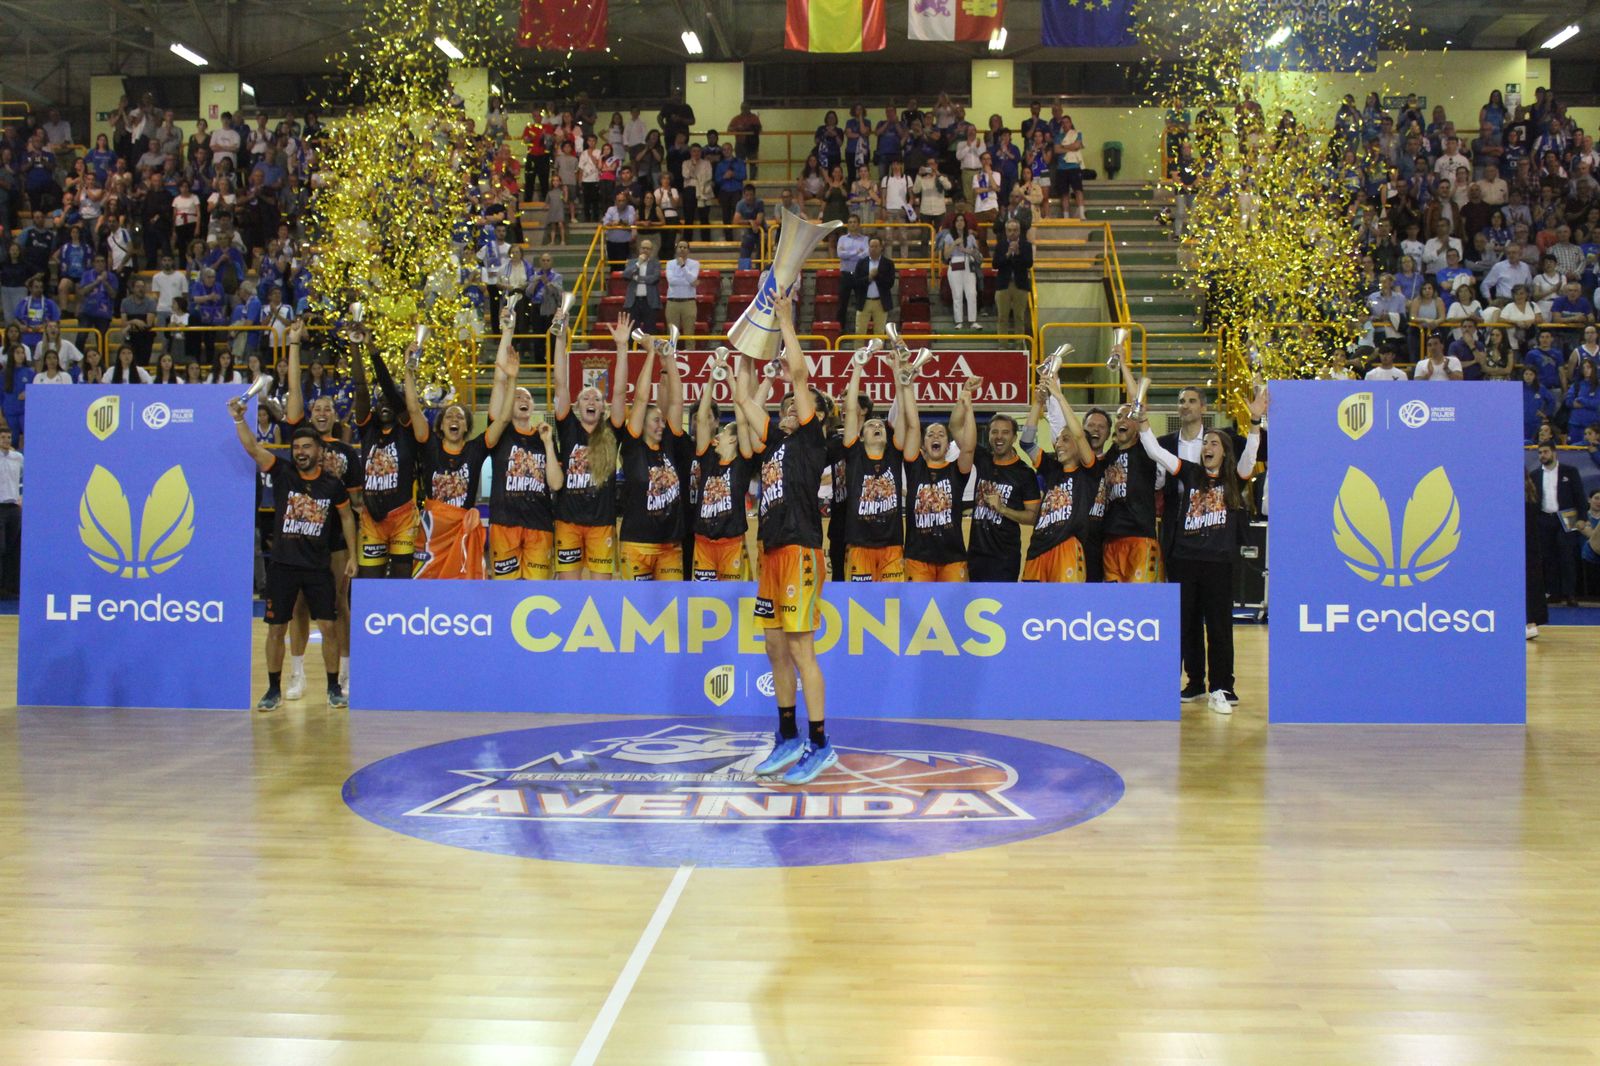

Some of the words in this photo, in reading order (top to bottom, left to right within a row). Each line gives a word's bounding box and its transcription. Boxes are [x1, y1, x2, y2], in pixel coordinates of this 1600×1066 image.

[675, 354, 977, 378] SALMACA
[864, 382, 1018, 401] HUANIAD
[94, 405, 113, 432] 100
[1345, 403, 1366, 431] 100
[859, 494, 897, 515] CAMPIONES
[1185, 510, 1227, 530] CAMPIONES
[46, 594, 91, 620] LF
[97, 593, 223, 622] endesa
[1299, 604, 1349, 632] LF
[1356, 602, 1495, 633] endesa
[365, 607, 492, 636] endesa
[1022, 611, 1160, 641] endesa
[710, 674, 728, 698] 100
[443, 788, 1000, 818] AVENIDA
